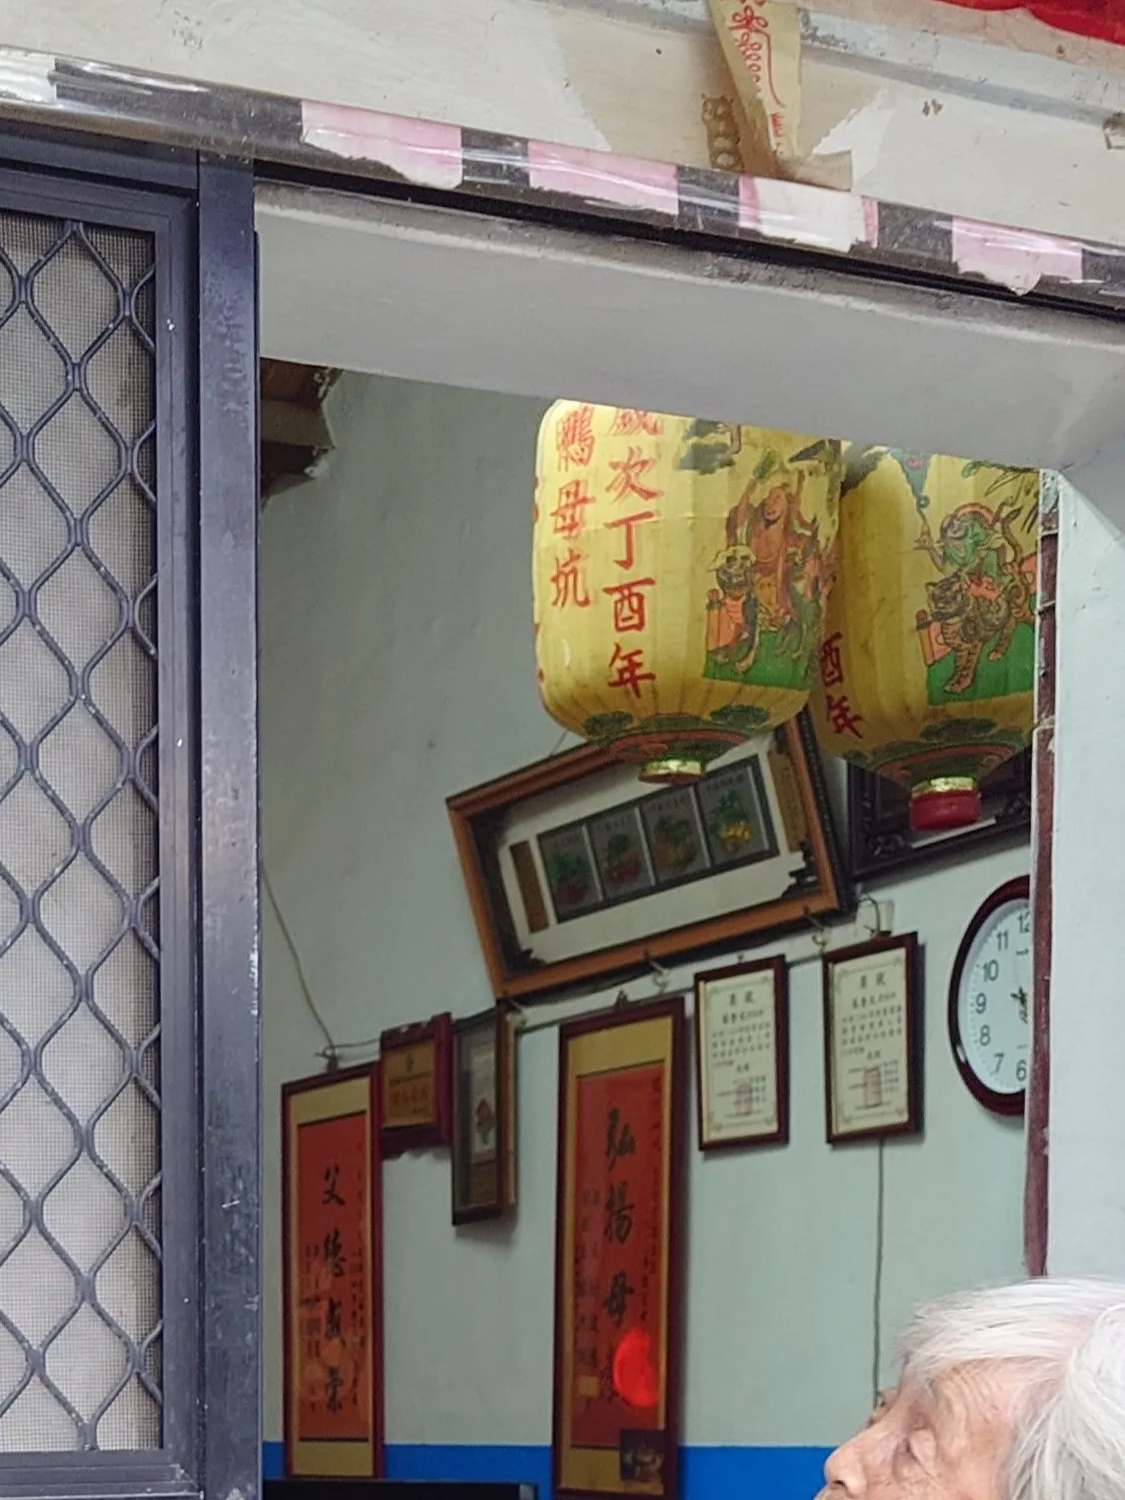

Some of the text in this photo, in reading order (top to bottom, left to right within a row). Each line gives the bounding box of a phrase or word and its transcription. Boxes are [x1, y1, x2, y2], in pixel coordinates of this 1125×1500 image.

[997, 930, 1009, 951] 11
[983, 959, 999, 982] 10
[975, 993, 987, 1014] 9
[979, 1024, 991, 1046] 8
[994, 1053, 1005, 1074] 7
[1015, 1059, 1026, 1081] 6
